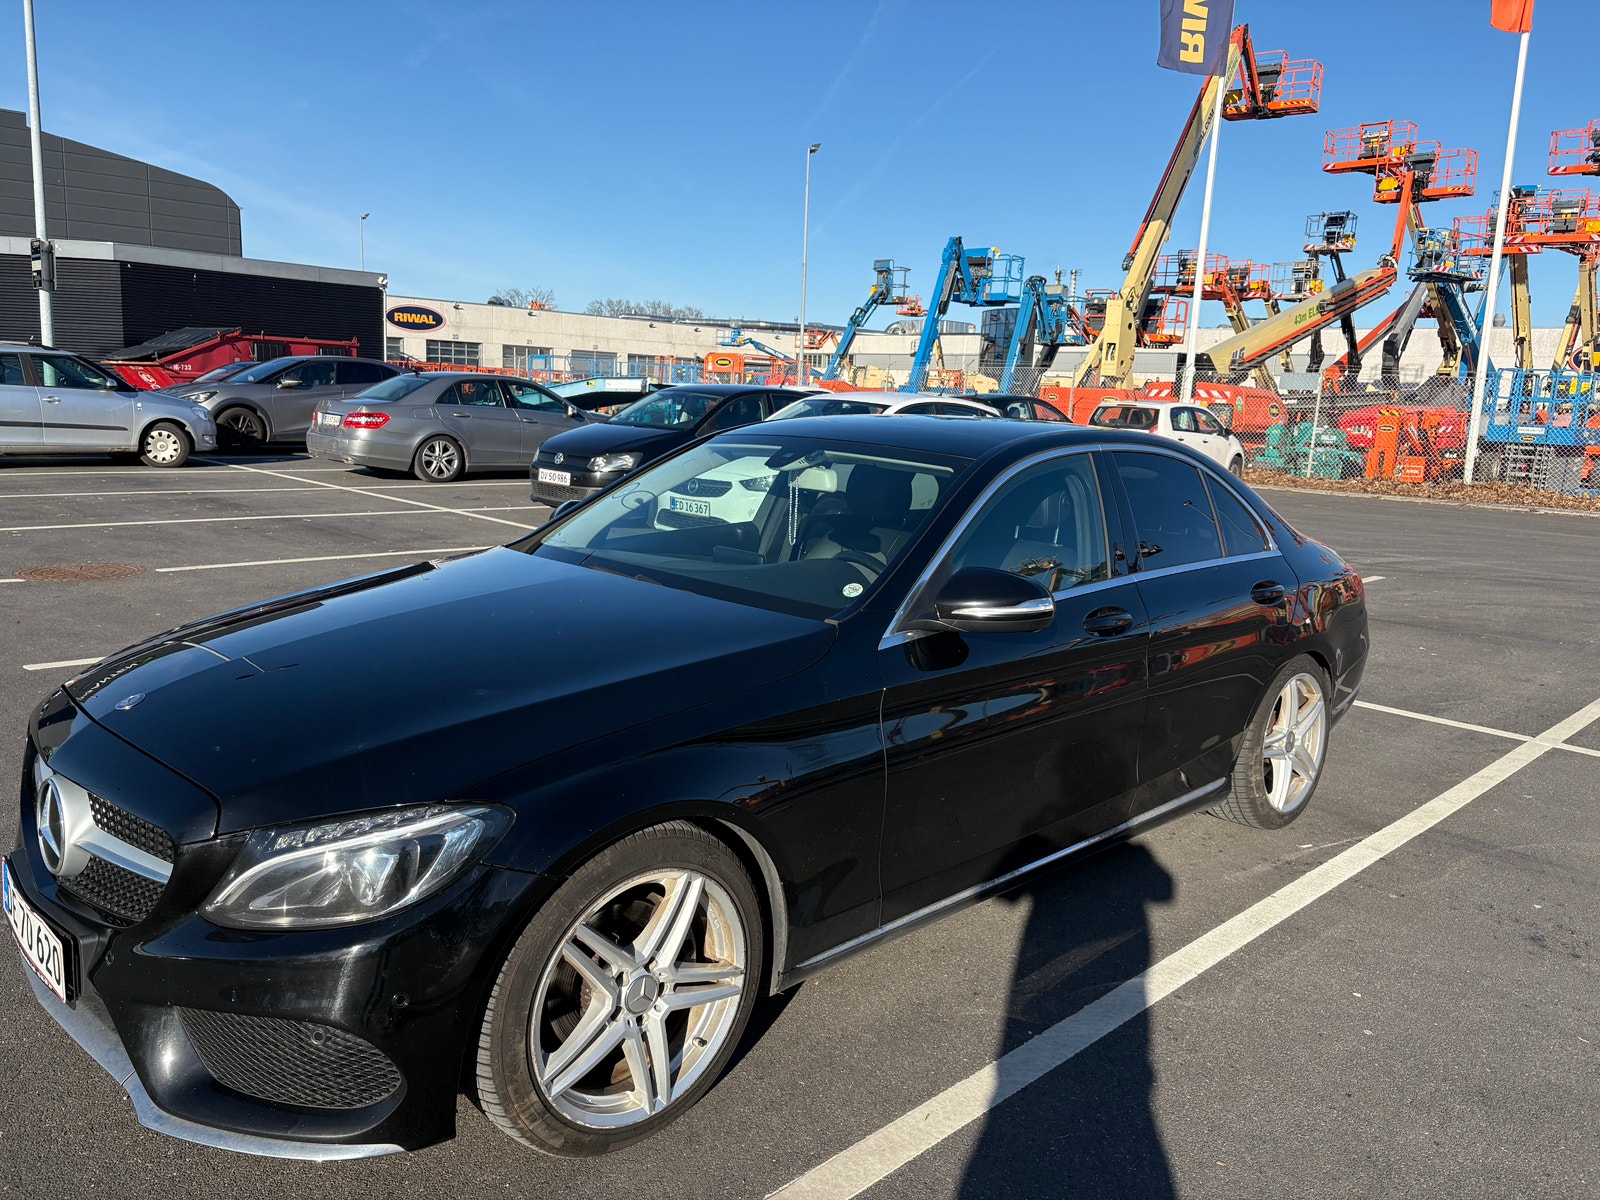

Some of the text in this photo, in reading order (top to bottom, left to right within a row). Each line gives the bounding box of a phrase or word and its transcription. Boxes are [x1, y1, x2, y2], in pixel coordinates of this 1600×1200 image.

[394, 312, 436, 325] RIWAL
[548, 472, 557, 481] 50
[675, 500, 708, 514] ED 16 367
[19, 902, 33, 951] 70
[36, 925, 62, 986] 620
